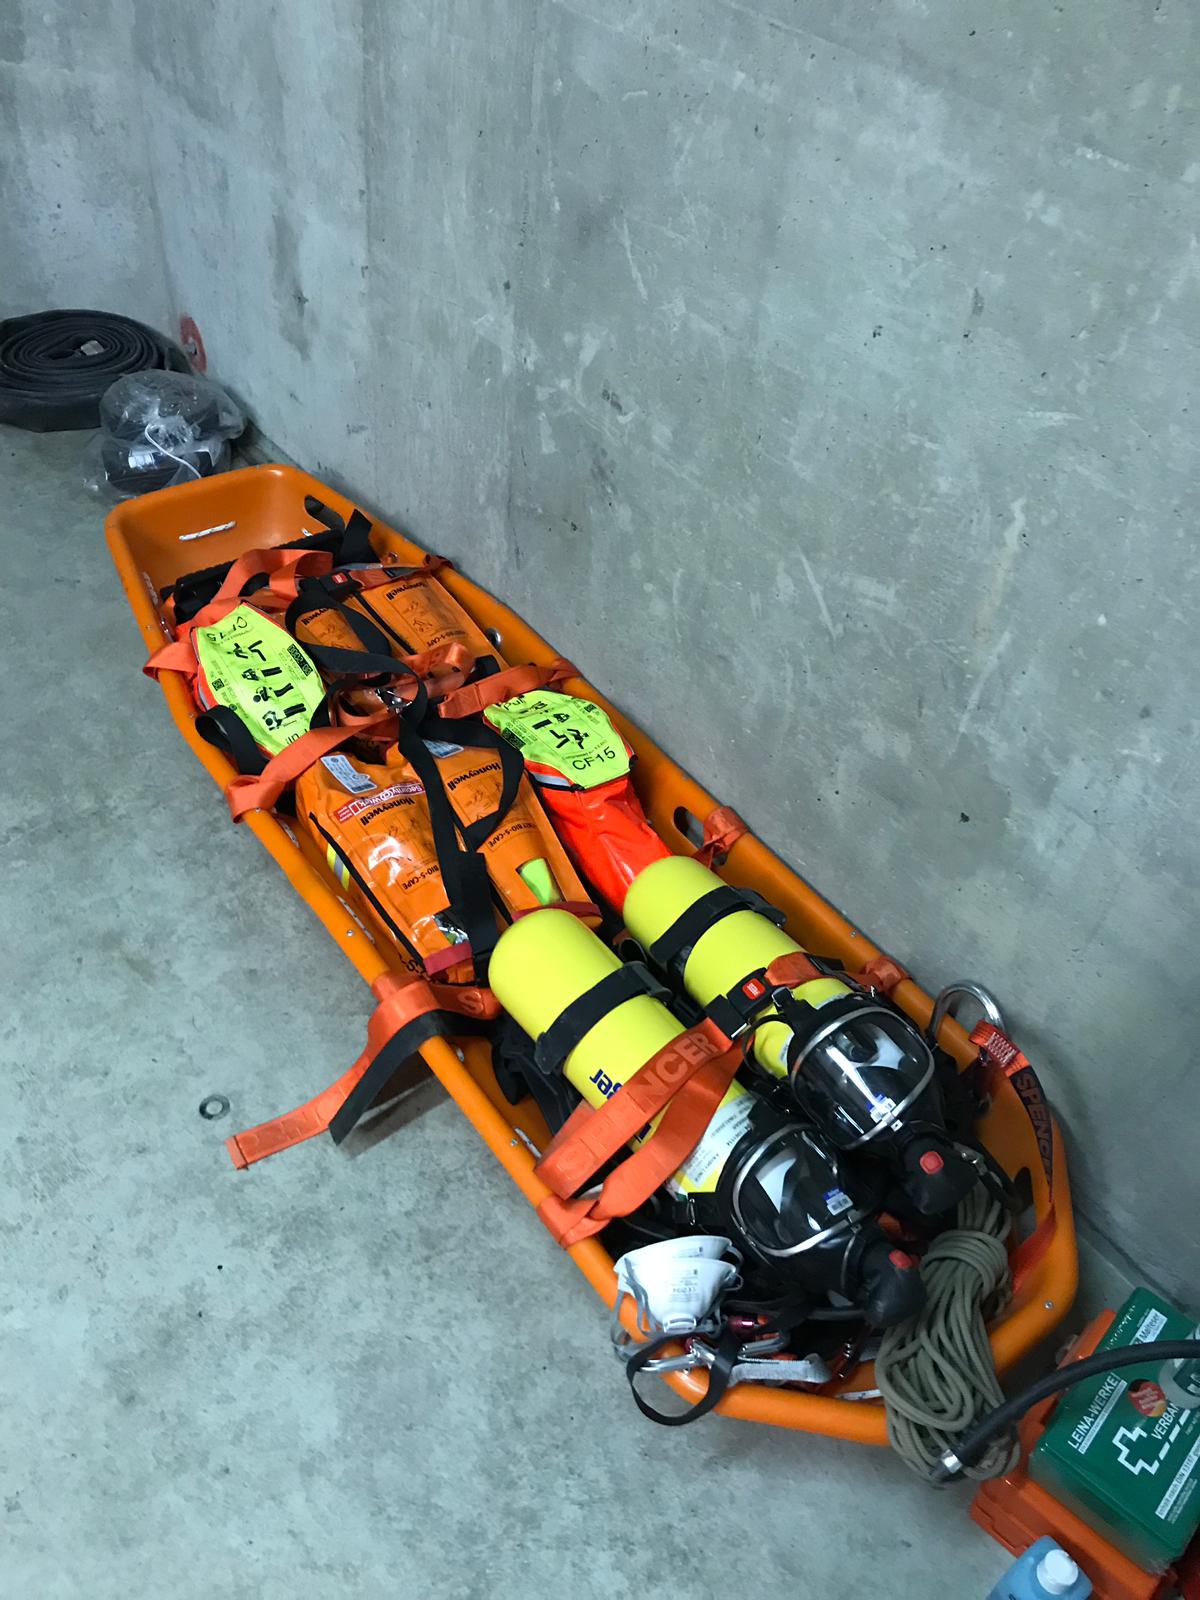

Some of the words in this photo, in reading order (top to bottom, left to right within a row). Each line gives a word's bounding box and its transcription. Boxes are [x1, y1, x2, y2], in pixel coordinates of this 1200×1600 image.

[572, 746, 617, 771] CF15
[447, 761, 502, 791] Honeywell
[360, 796, 416, 826] Honeywell
[402, 864, 440, 890] BIO-S-CAPE
